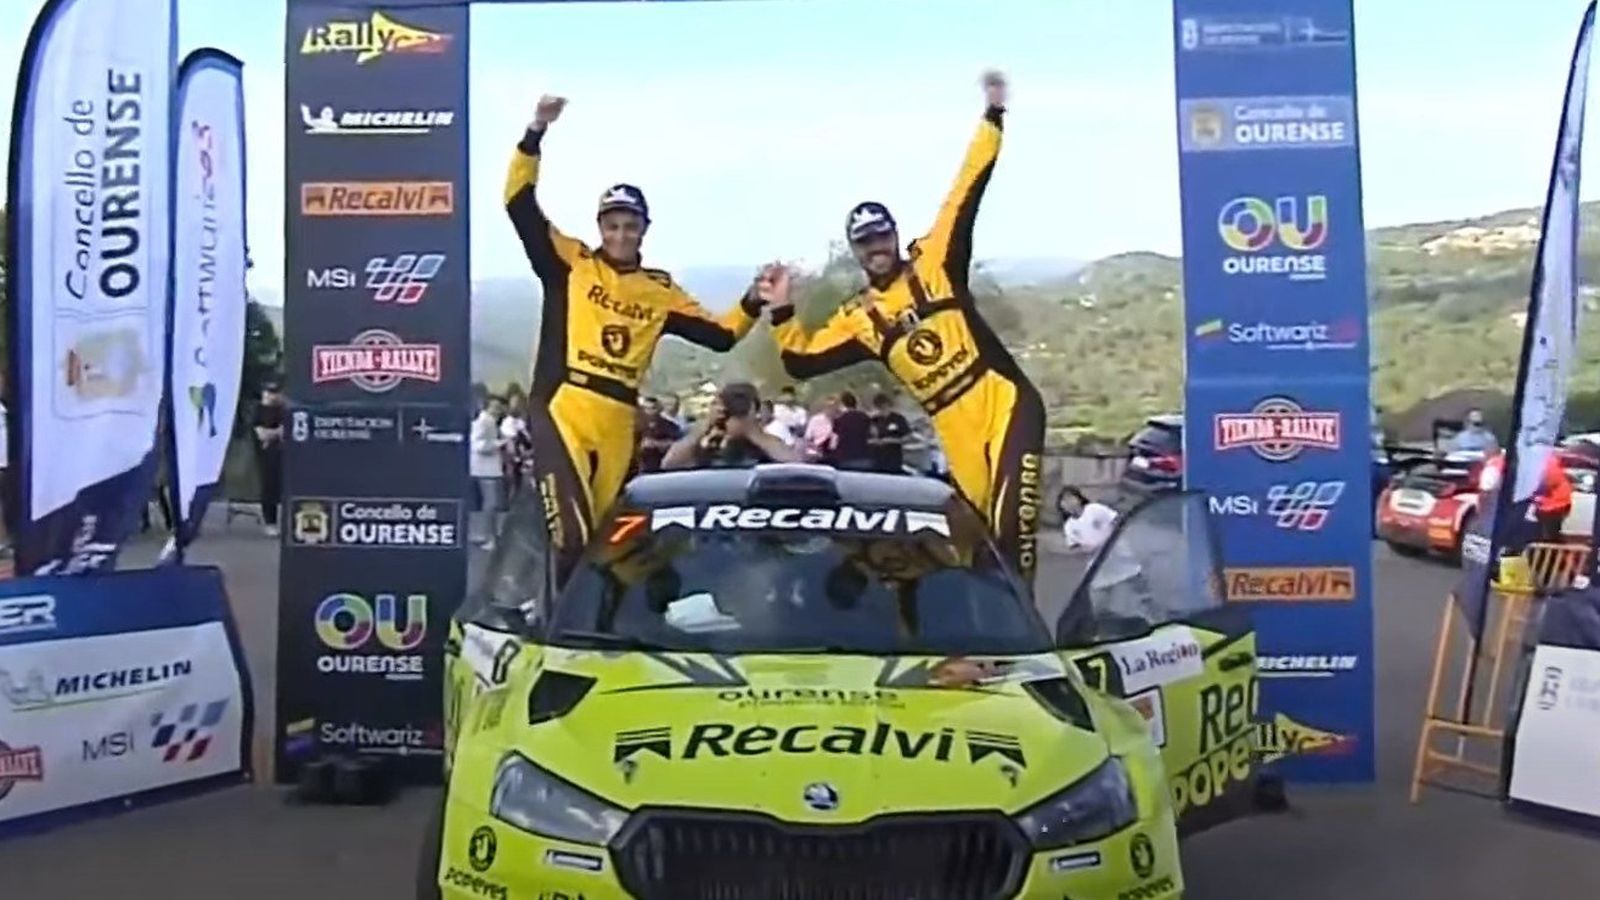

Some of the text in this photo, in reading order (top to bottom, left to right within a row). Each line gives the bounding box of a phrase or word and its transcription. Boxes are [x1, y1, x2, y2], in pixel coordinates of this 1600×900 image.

[340, 111, 454, 126] MICHELIN
[1234, 121, 1345, 143] OURENSE
[64, 99, 96, 299] Concello de
[99, 69, 142, 298] OURENSE
[328, 186, 427, 211] Recalvi
[1217, 195, 1329, 252] OU
[340, 503, 437, 520] Concello de
[699, 504, 901, 533] Recalvi
[340, 524, 455, 545] OURENSE
[610, 513, 649, 544] 7
[315, 593, 428, 650] OU
[55, 660, 193, 696] MICHELIN
[316, 655, 424, 673] OURENSE
[1086, 657, 1108, 693] 7
[81, 731, 135, 762] MSi
[681, 721, 955, 762] Recalvi
